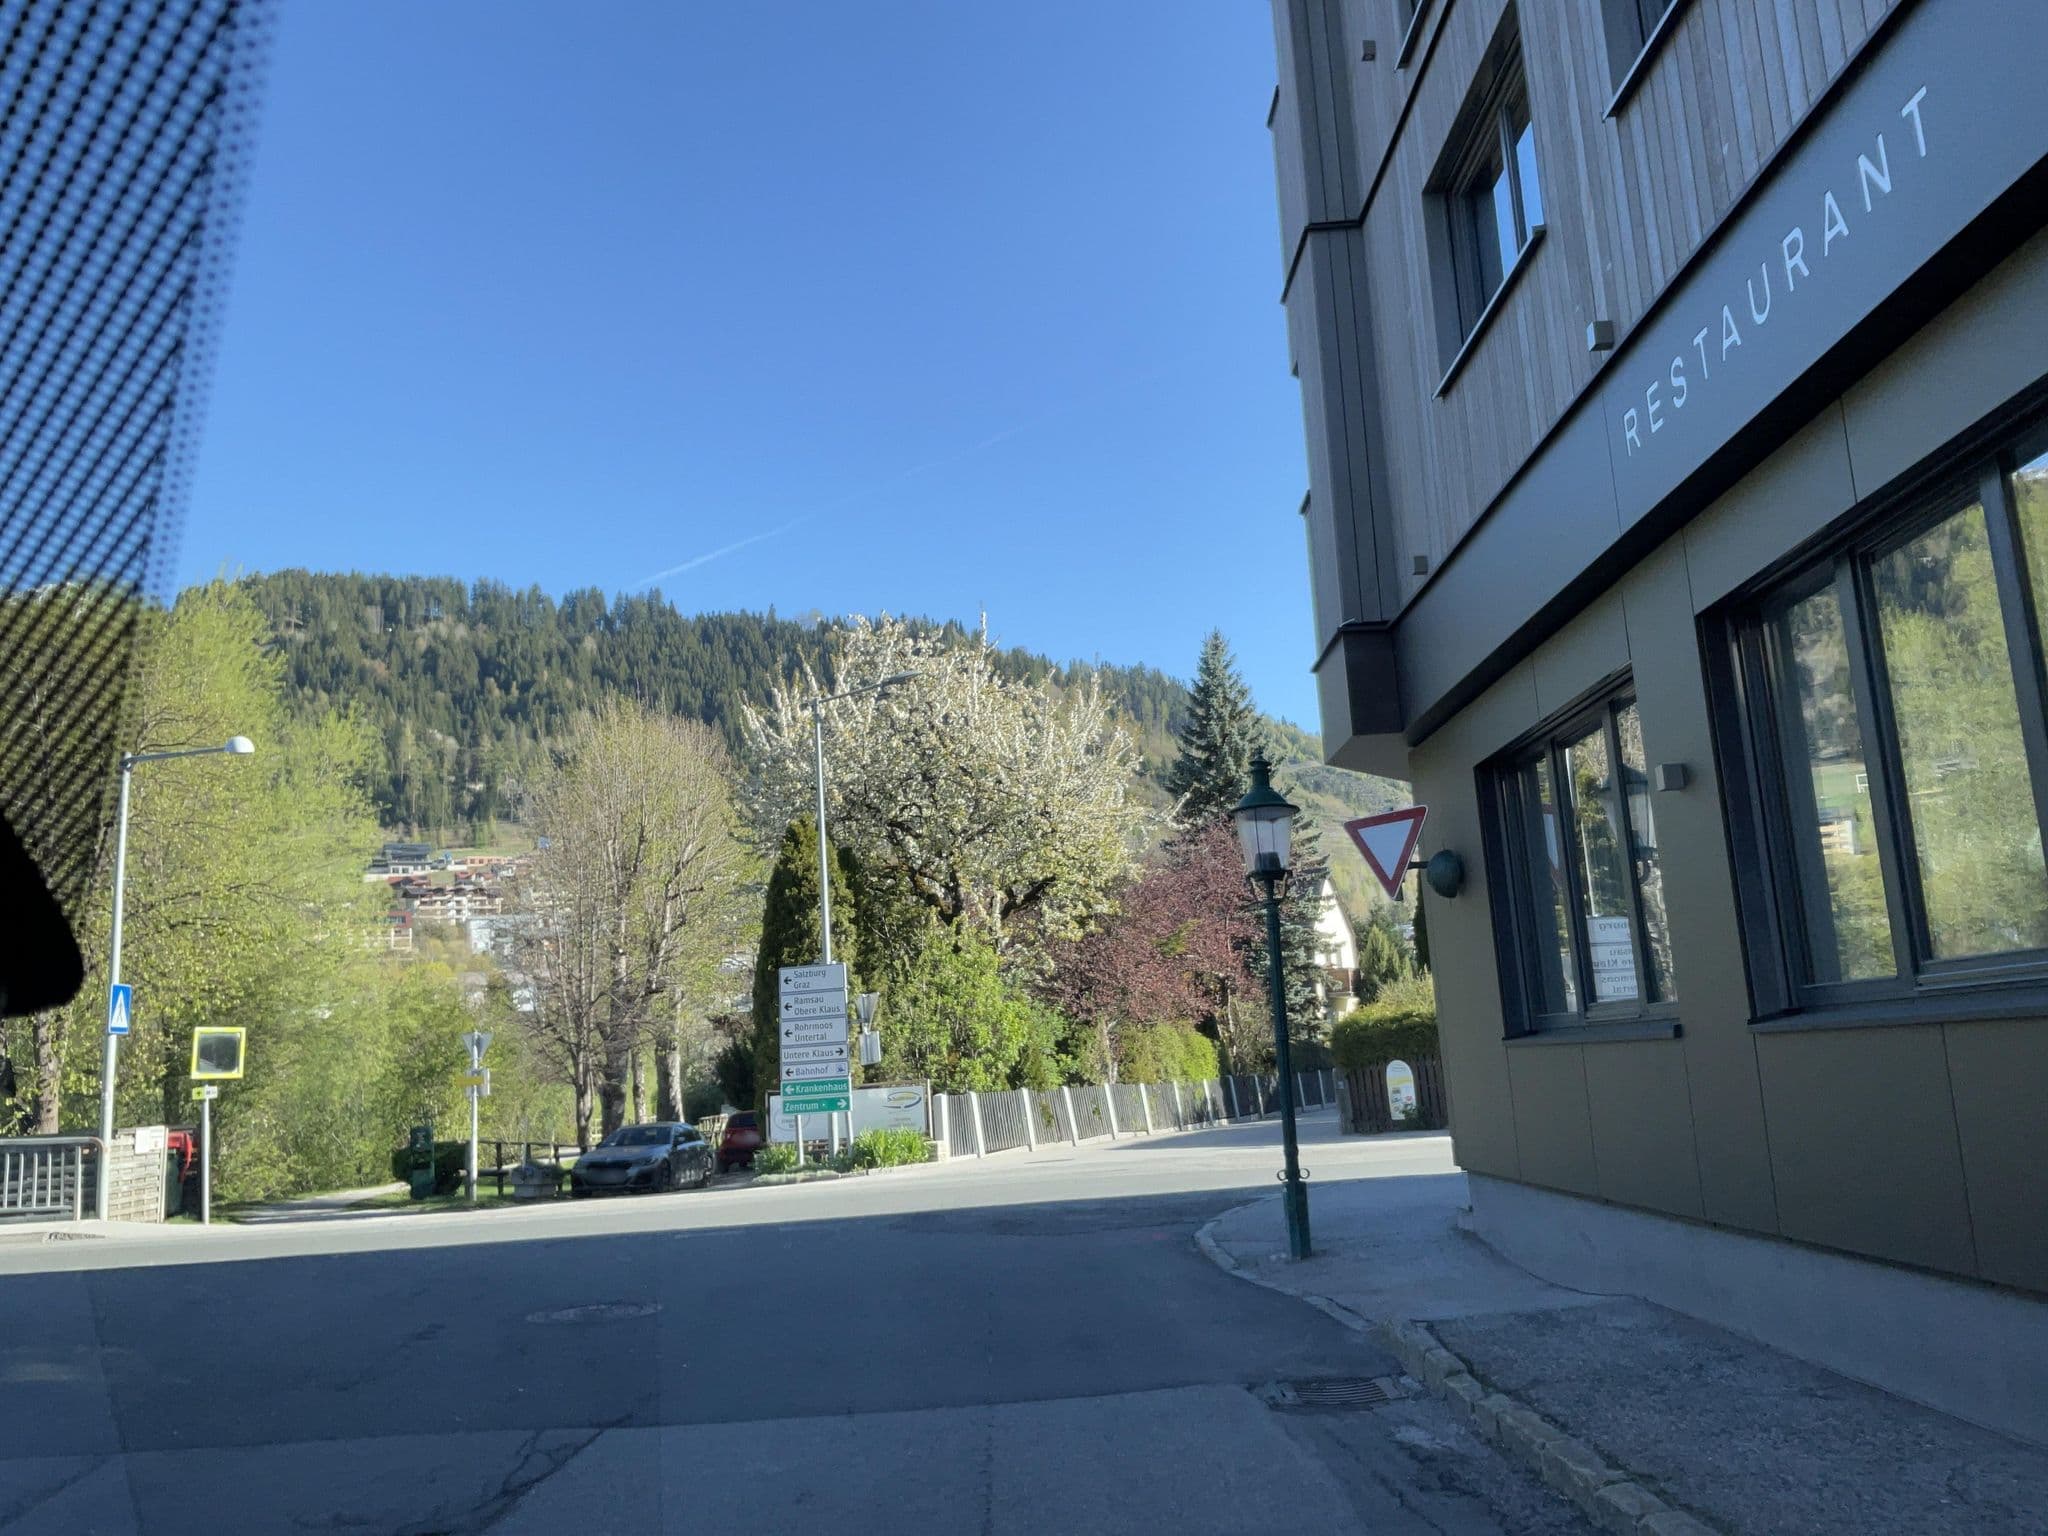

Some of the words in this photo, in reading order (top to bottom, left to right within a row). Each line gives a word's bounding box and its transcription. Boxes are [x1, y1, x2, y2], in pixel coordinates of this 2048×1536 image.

[1623, 85, 1927, 457] RESTAURANT
[793, 969, 826, 979] Salzburg
[793, 981, 811, 989] Graz
[793, 996, 824, 1005] Ramsau
[794, 1007, 817, 1016] Obere
[819, 1004, 841, 1014] Klaus
[794, 1022, 833, 1031] Rohrmoos
[794, 1033, 827, 1042] Untertal
[783, 1051, 810, 1060] Untere
[812, 1049, 834, 1057] Klaus
[795, 1065, 829, 1076] Bahnhof
[795, 1083, 847, 1094] Krankenhaus
[784, 1102, 819, 1112] Zentrum
